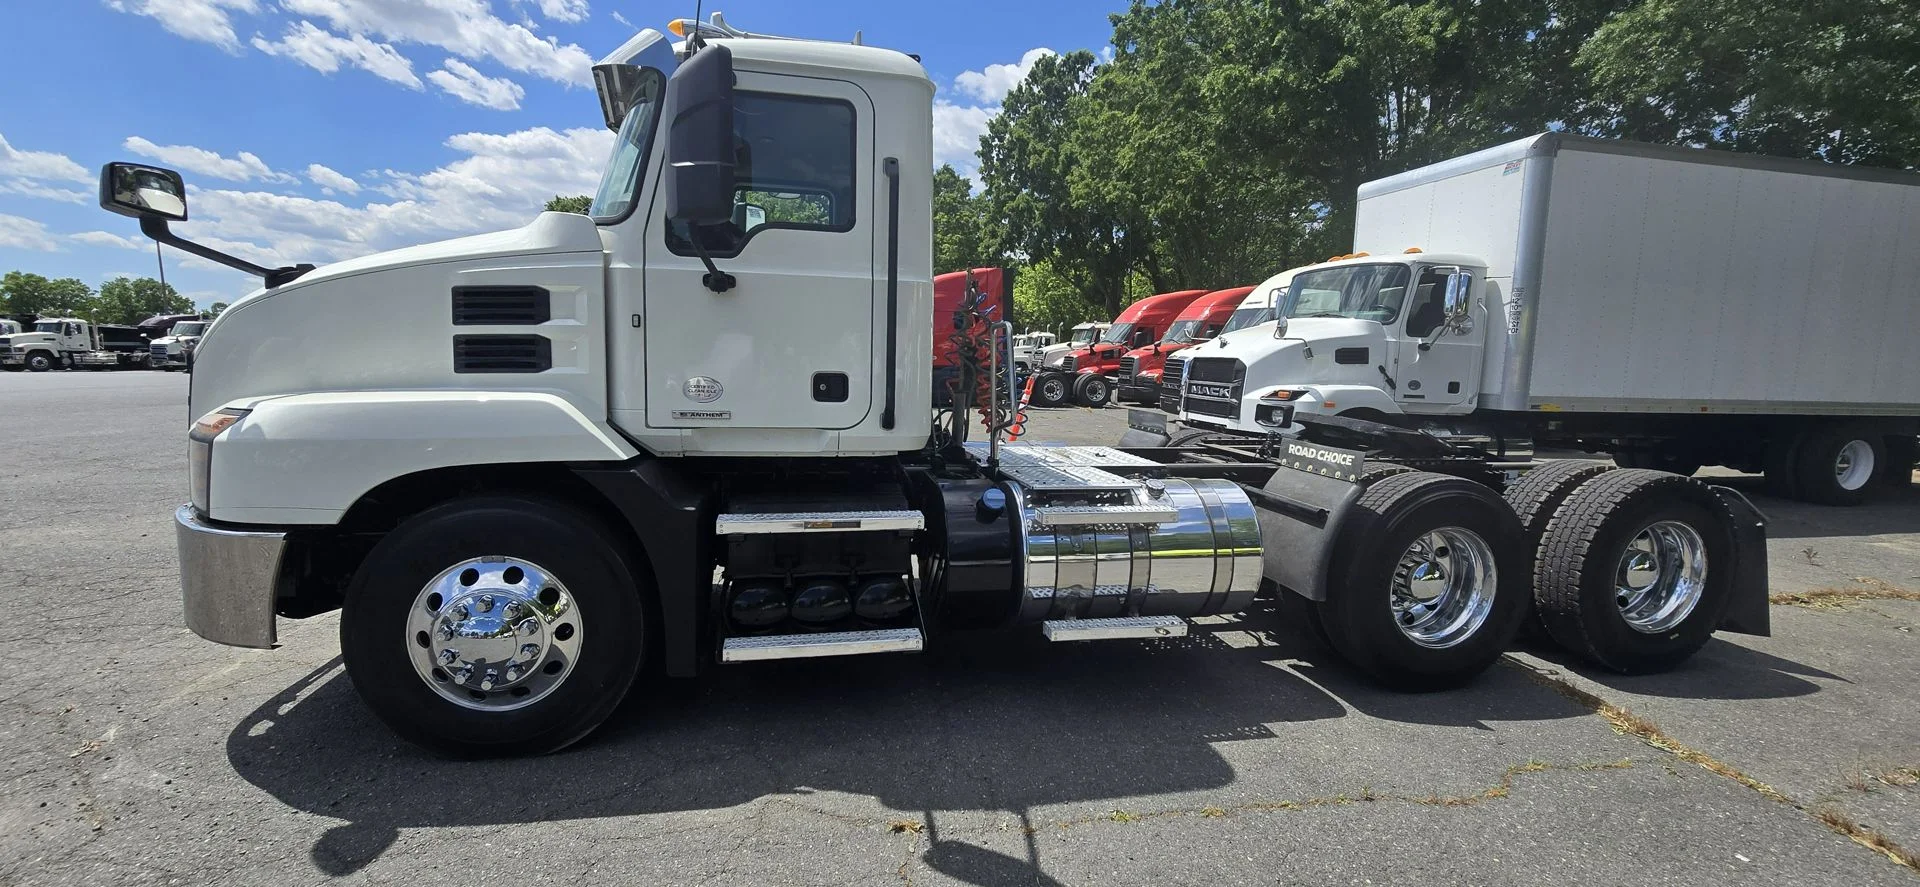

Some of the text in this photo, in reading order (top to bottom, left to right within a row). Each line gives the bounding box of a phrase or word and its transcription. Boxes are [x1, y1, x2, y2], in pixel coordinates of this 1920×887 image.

[1190, 385, 1230, 397] MACK
[1288, 444, 1354, 466] ROAD CHOICE
